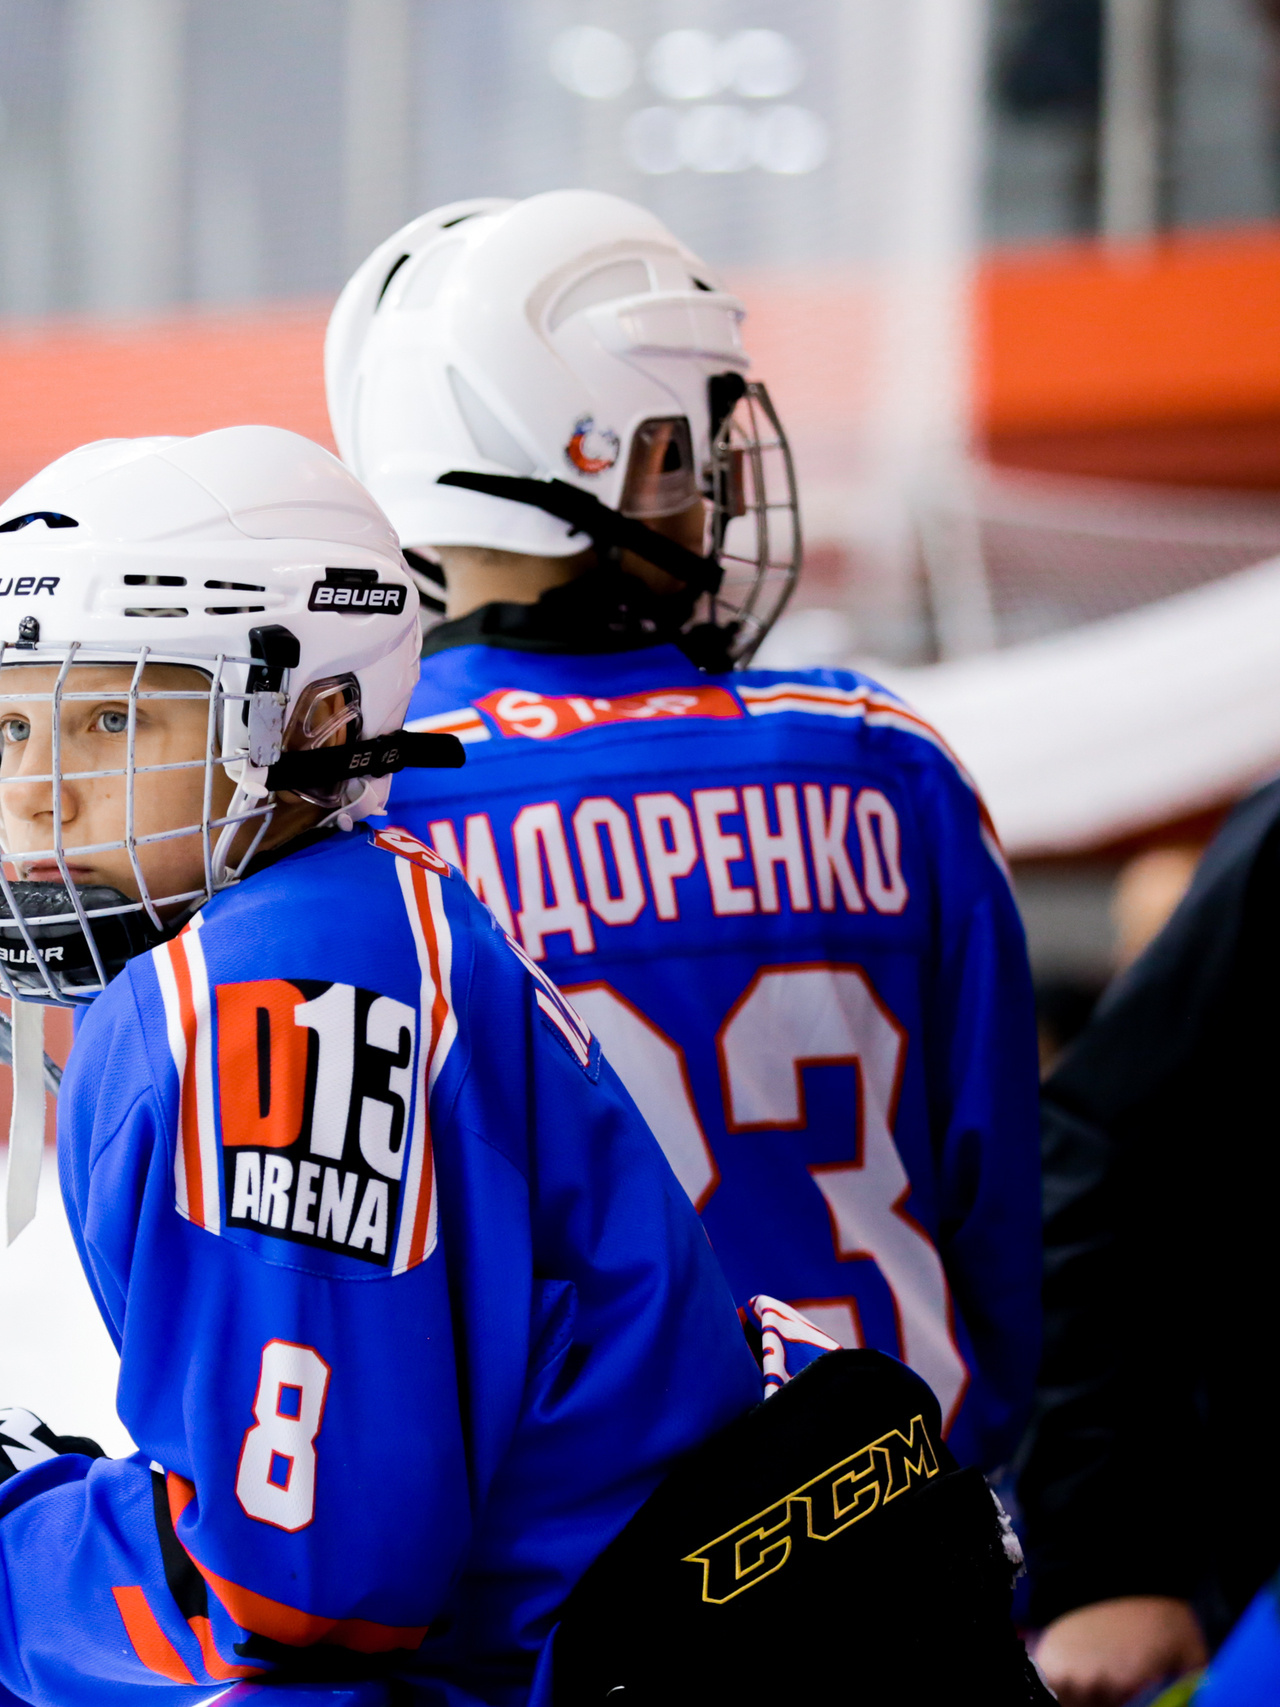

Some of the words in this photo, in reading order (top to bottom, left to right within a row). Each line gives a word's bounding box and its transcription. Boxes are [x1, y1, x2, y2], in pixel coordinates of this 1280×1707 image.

[314, 587, 400, 607] BAUER
[384, 783, 909, 962] ИДОРЕНКО
[215, 978, 417, 1181] D13
[231, 1151, 390, 1256] ARENA
[234, 1338, 332, 1534] 8
[681, 1413, 939, 1605] CCM
